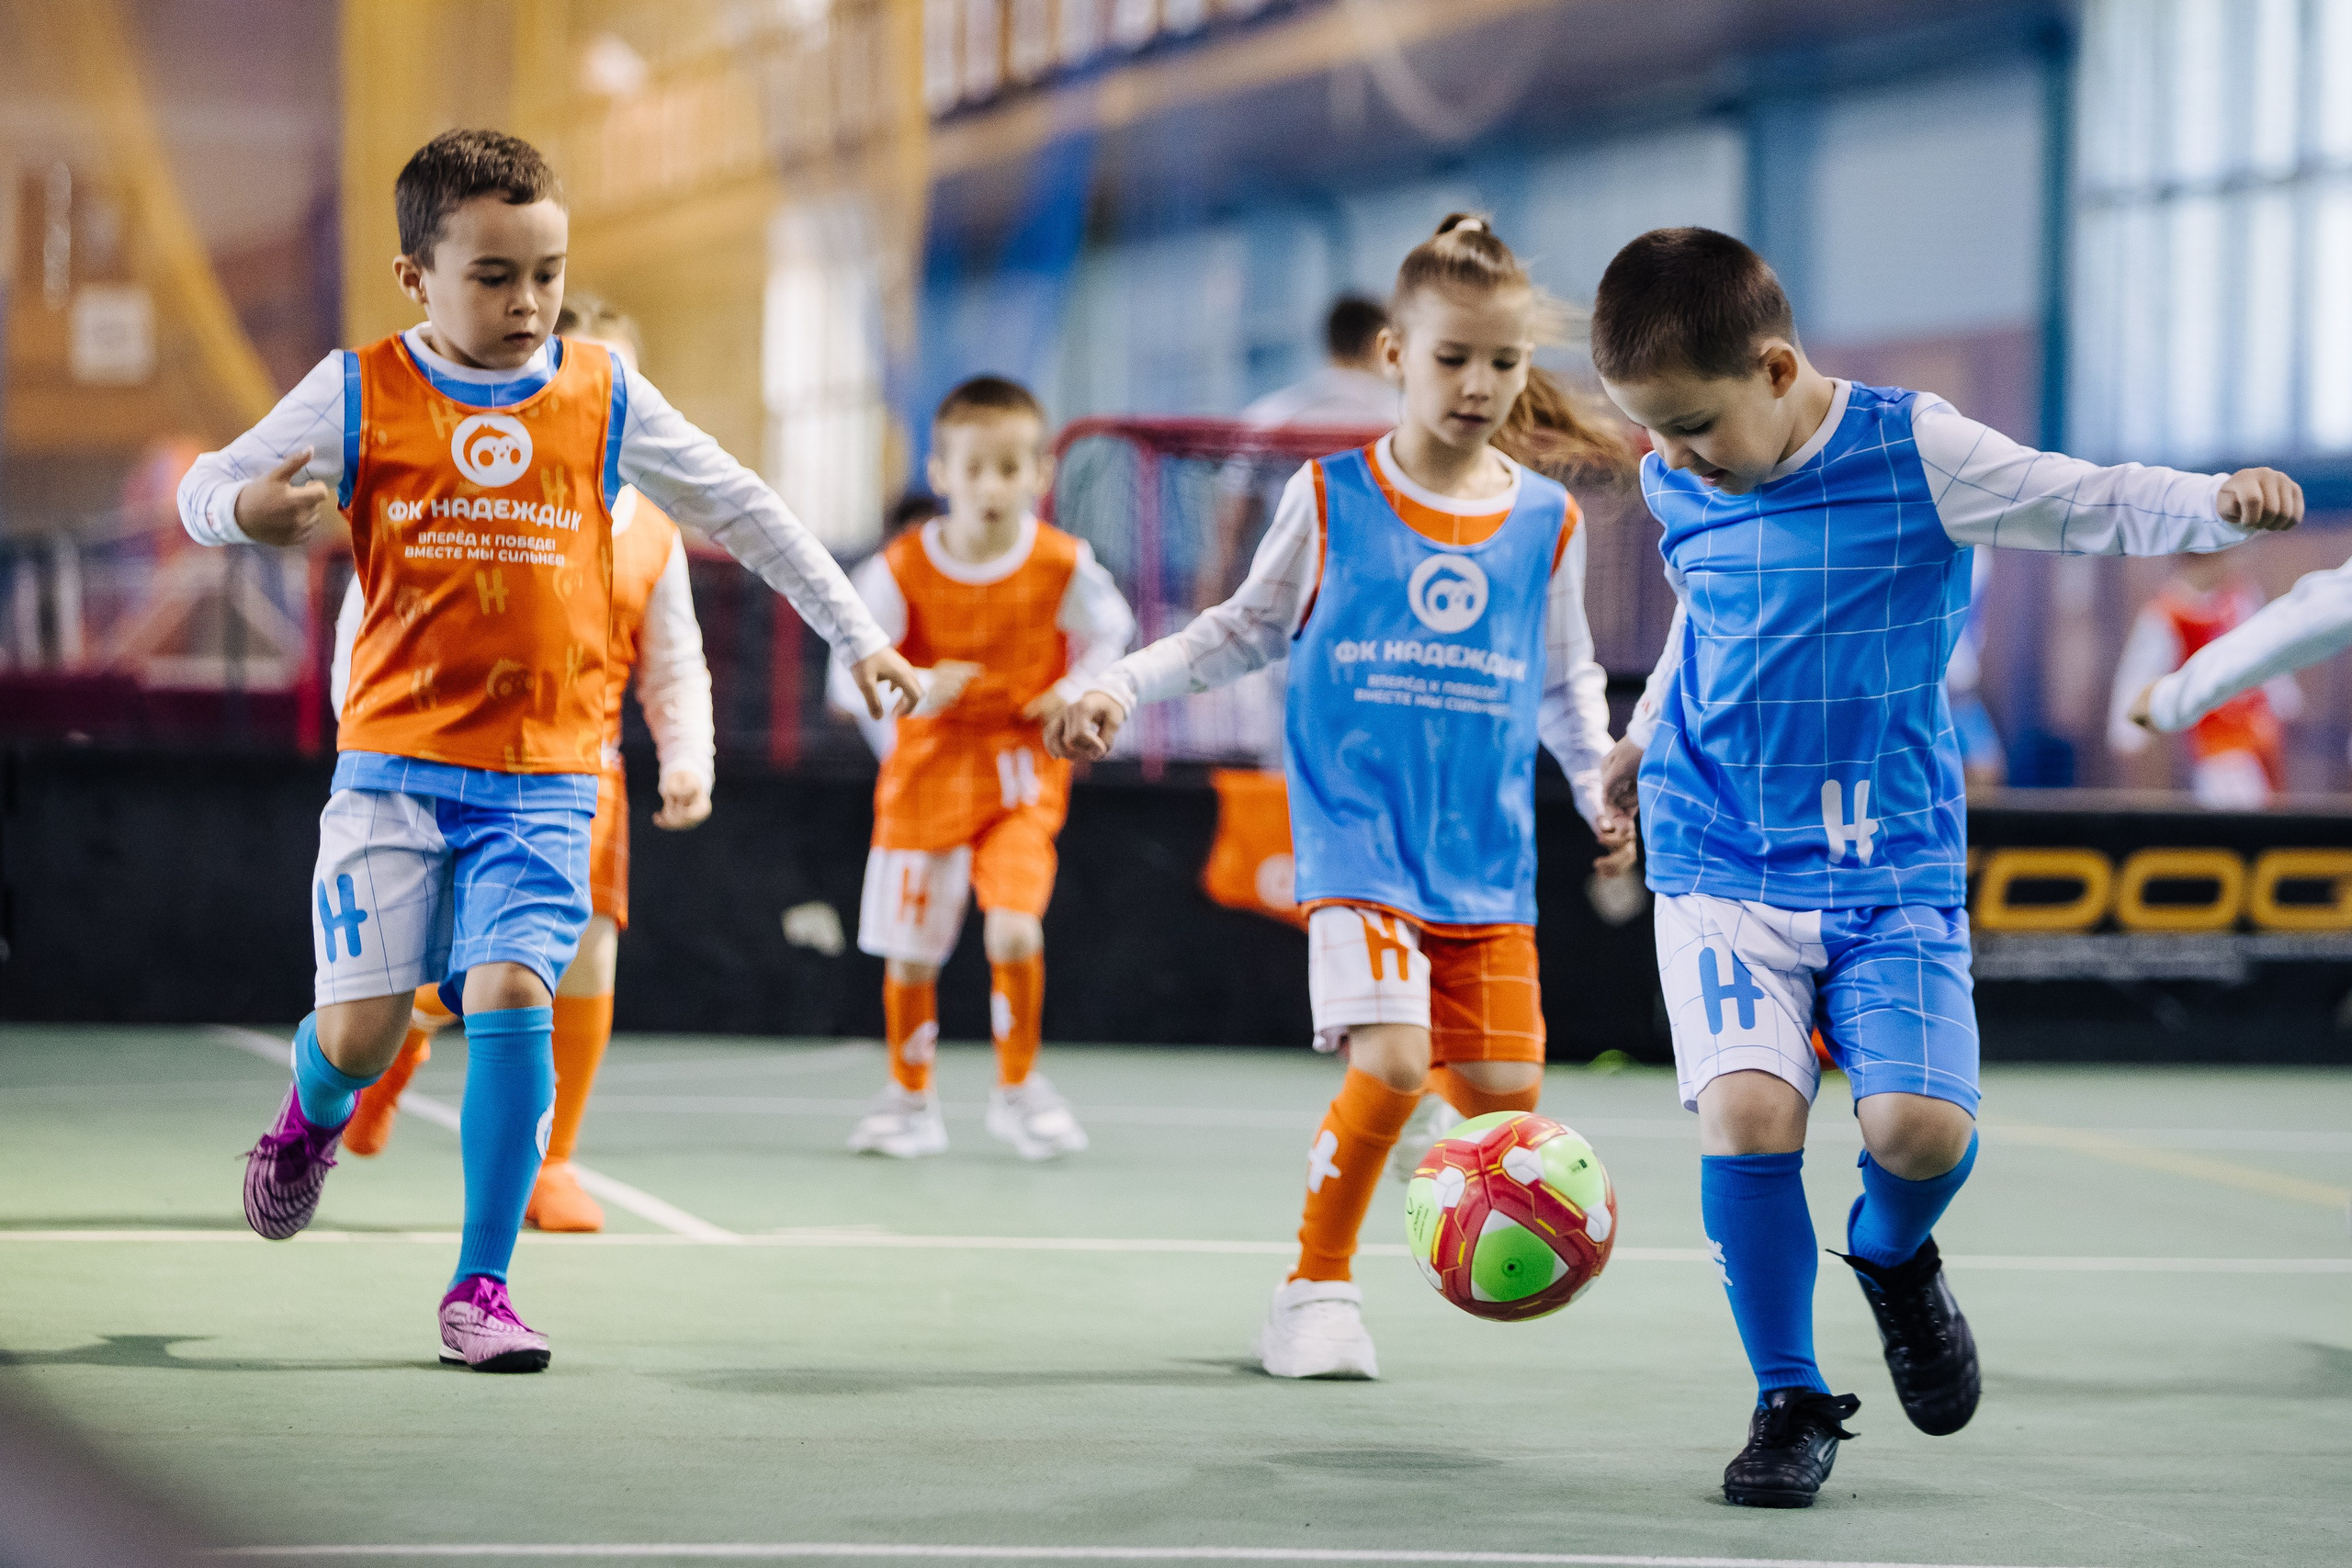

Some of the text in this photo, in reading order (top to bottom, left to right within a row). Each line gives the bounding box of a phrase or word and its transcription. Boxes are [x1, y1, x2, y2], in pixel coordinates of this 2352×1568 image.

[387, 497, 582, 533] ФК НАДЕЖДИК
[404, 546, 463, 560] ВМЕСТЕ
[467, 547, 494, 561] МЫ
[418, 529, 557, 552] ВПЕРЁД К ПОБЕДЕ!
[1334, 638, 1527, 682] ФК НАДЕЖДИК
[1967, 846, 2352, 931] DOG
